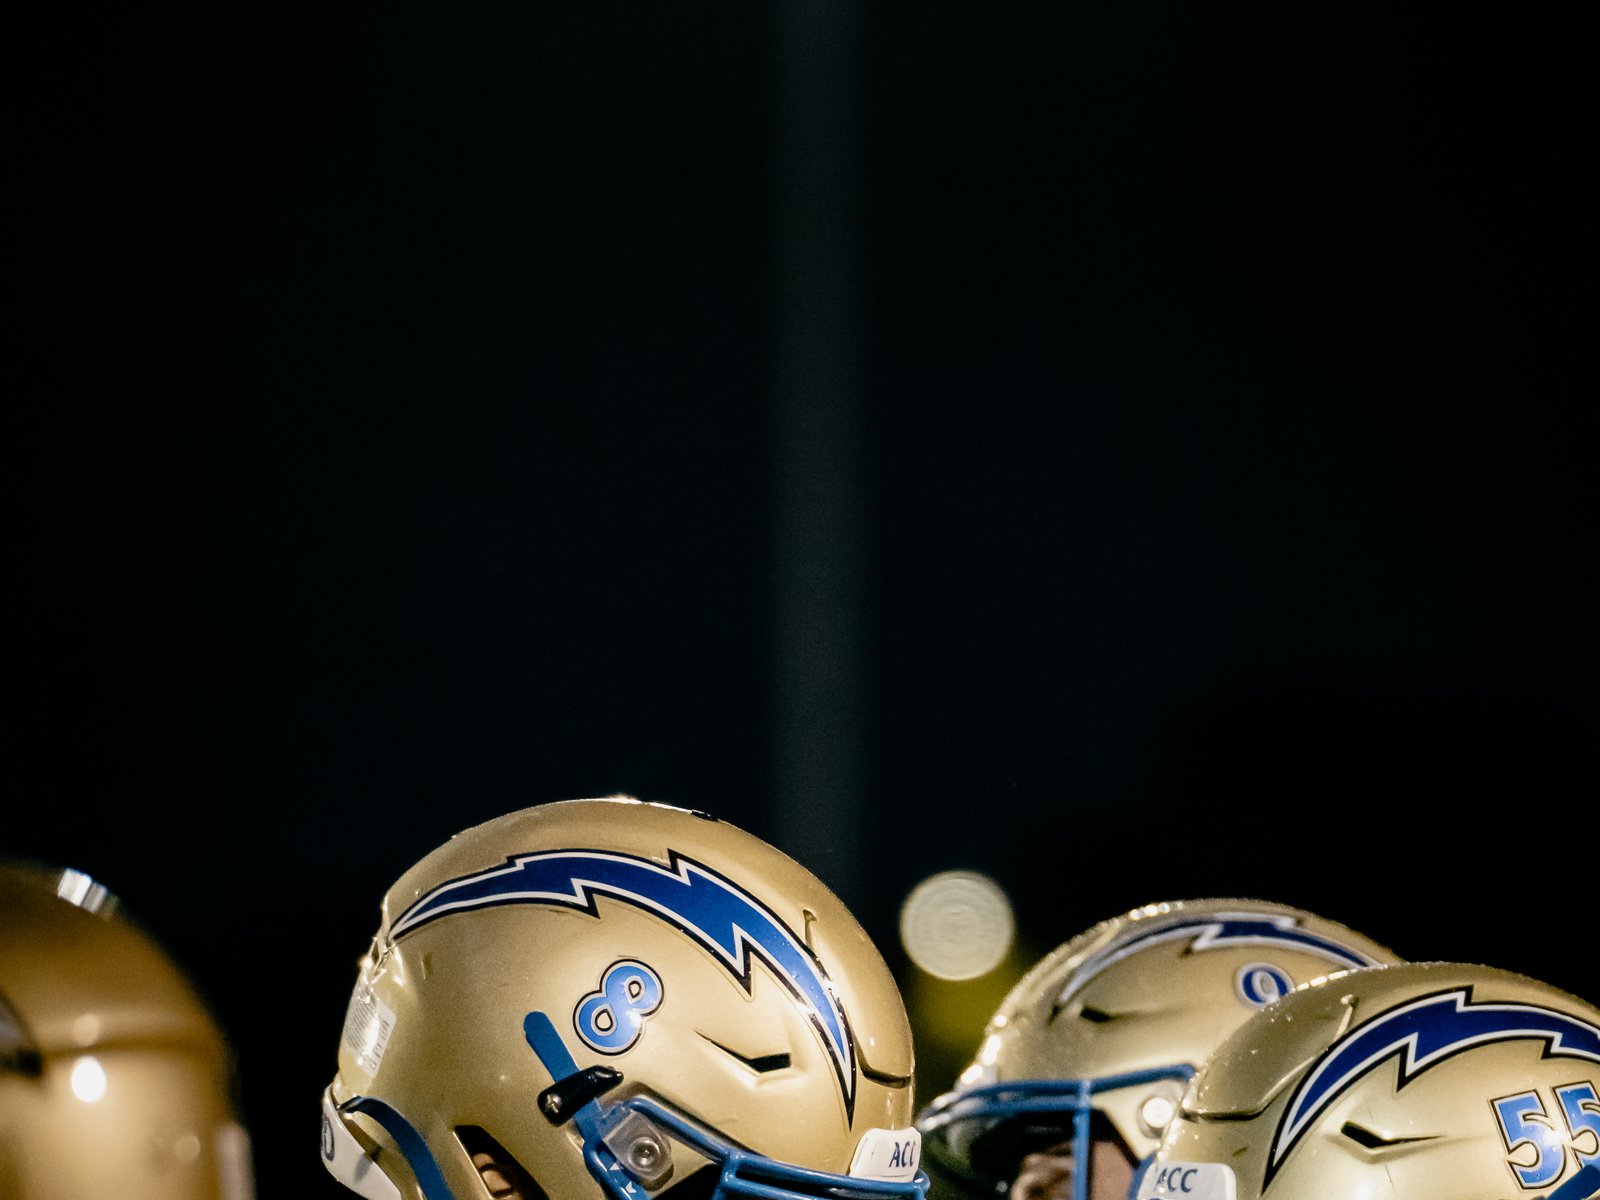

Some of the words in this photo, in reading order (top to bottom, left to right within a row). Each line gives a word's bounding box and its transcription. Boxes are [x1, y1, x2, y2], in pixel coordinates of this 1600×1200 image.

[573, 959, 664, 1056] 8
[1153, 1166, 1198, 1193] ACC
[1488, 1080, 1600, 1190] 55
